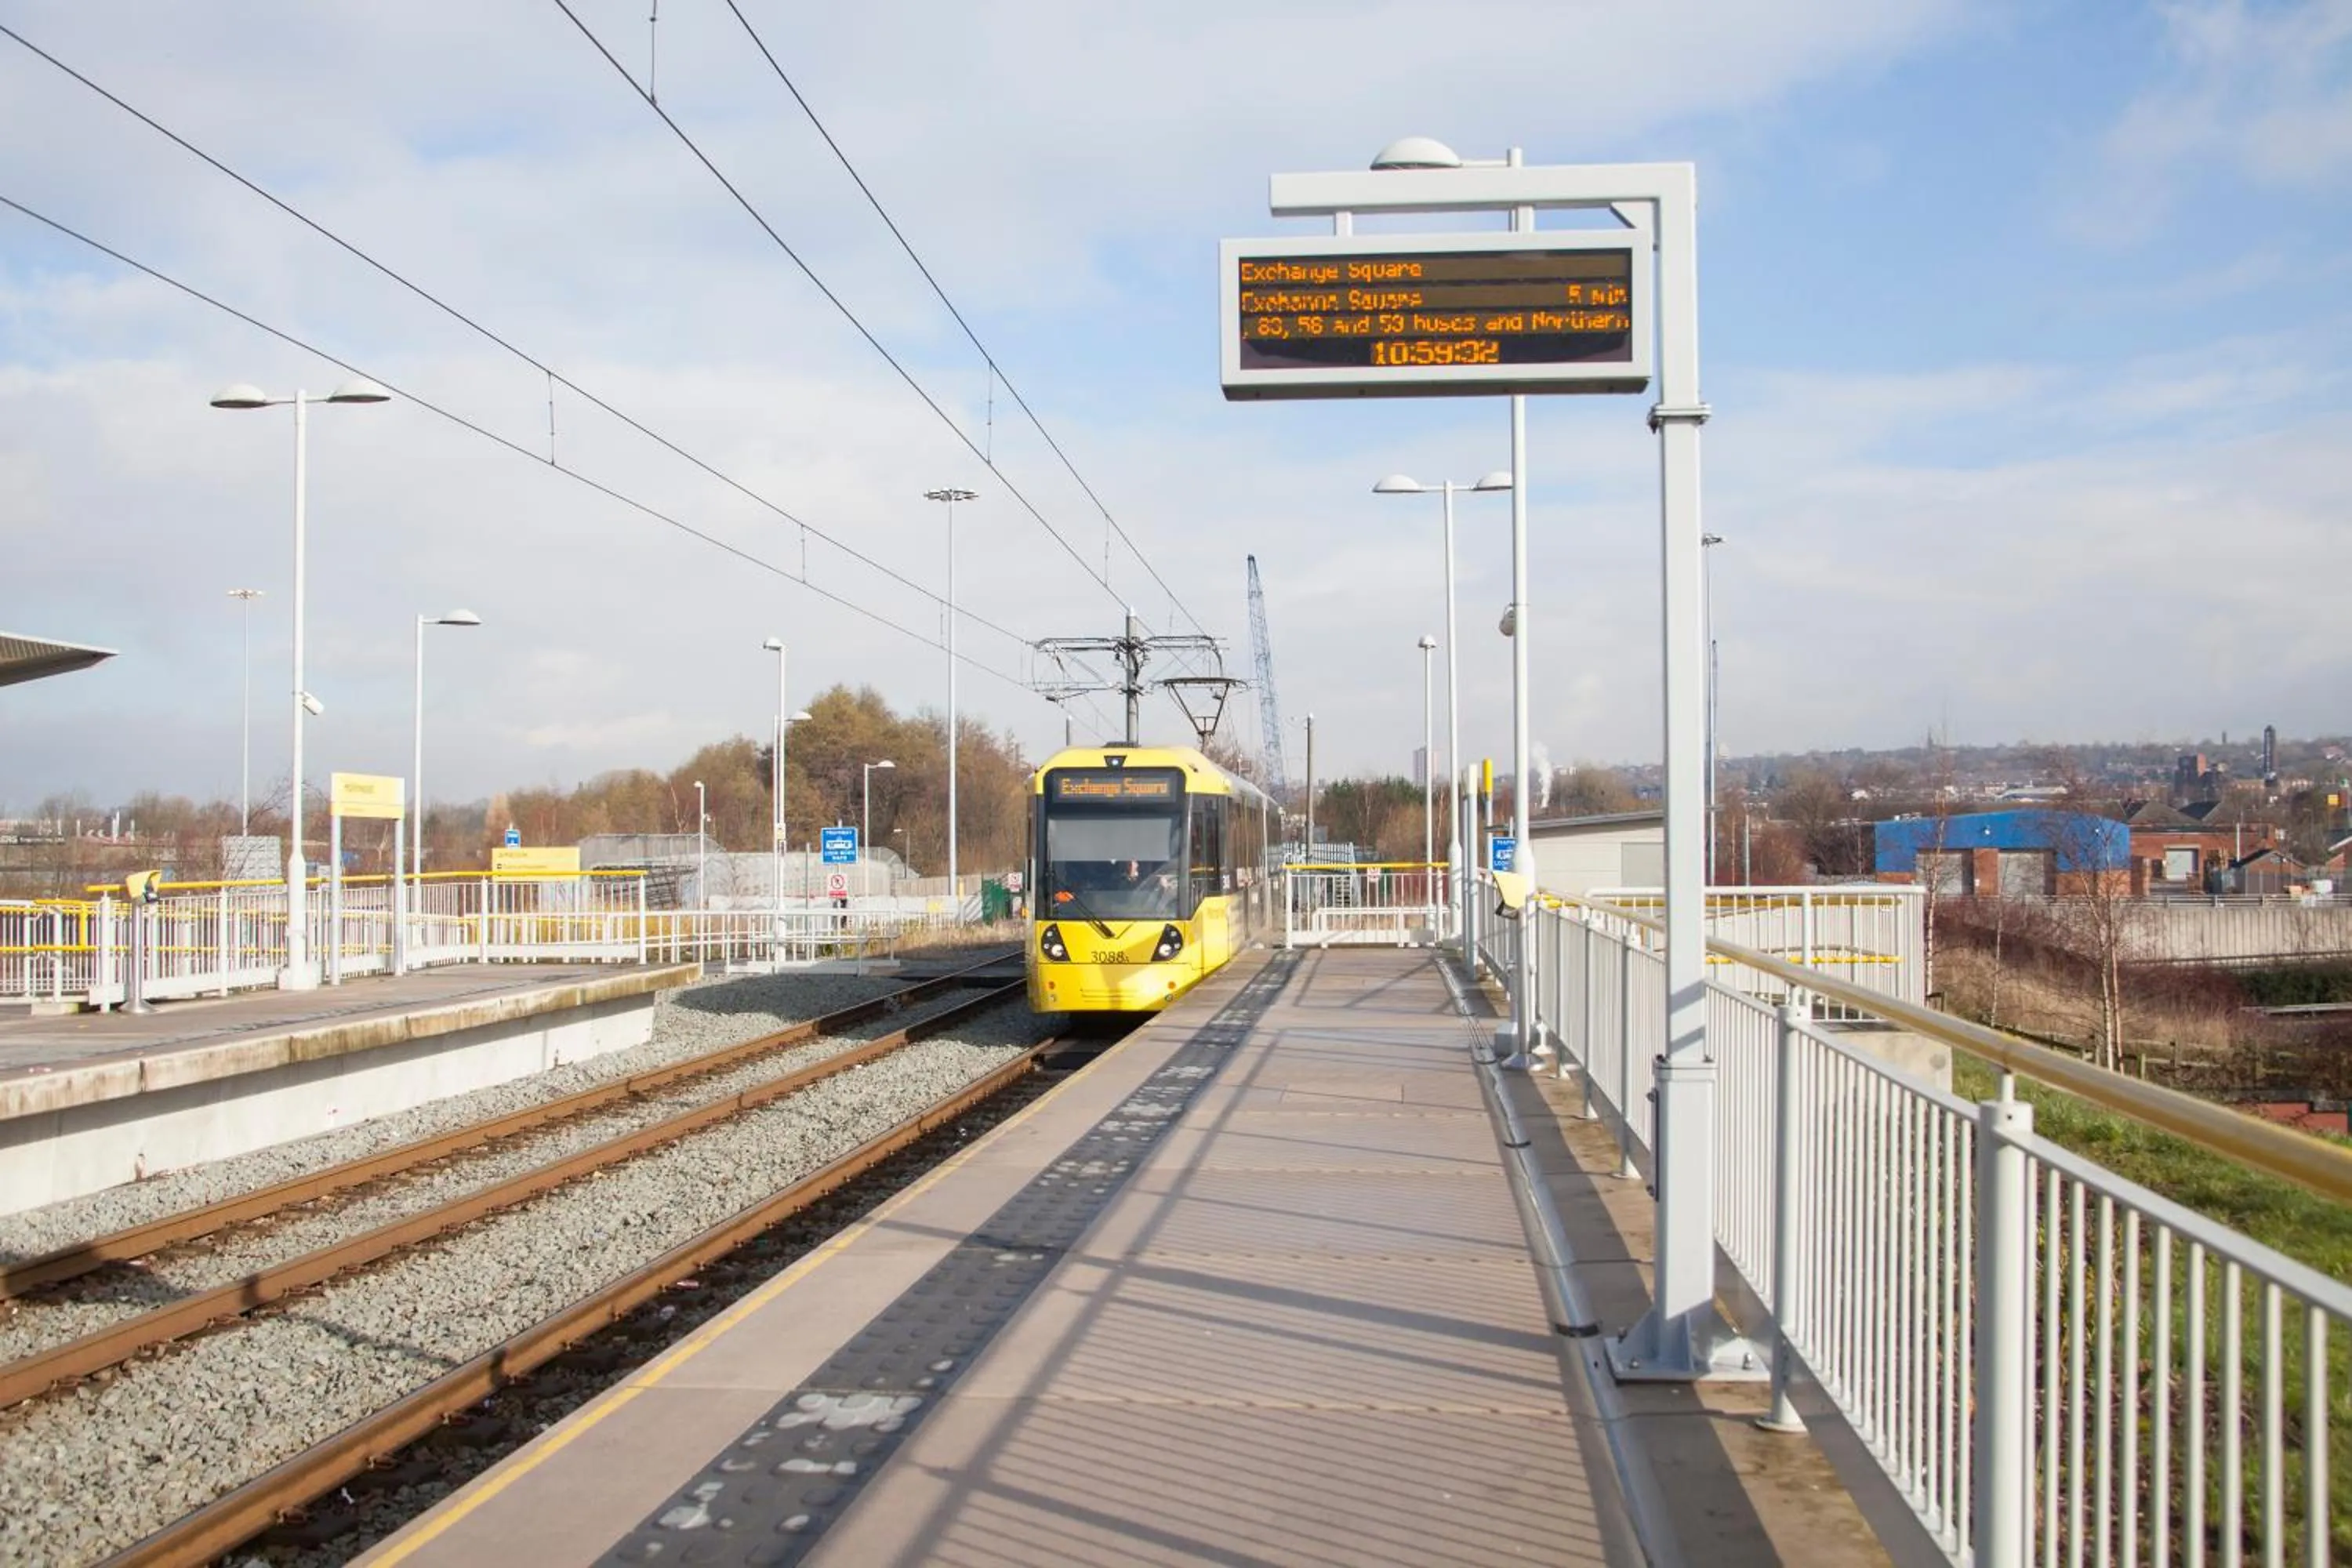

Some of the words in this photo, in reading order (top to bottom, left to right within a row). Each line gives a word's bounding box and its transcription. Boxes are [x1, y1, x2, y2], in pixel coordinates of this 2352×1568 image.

[1241, 262, 1339, 283] Exchange
[1348, 263, 1422, 282] Square
[1486, 314, 1523, 331] and
[1375, 340, 1500, 365] 10:59:32
